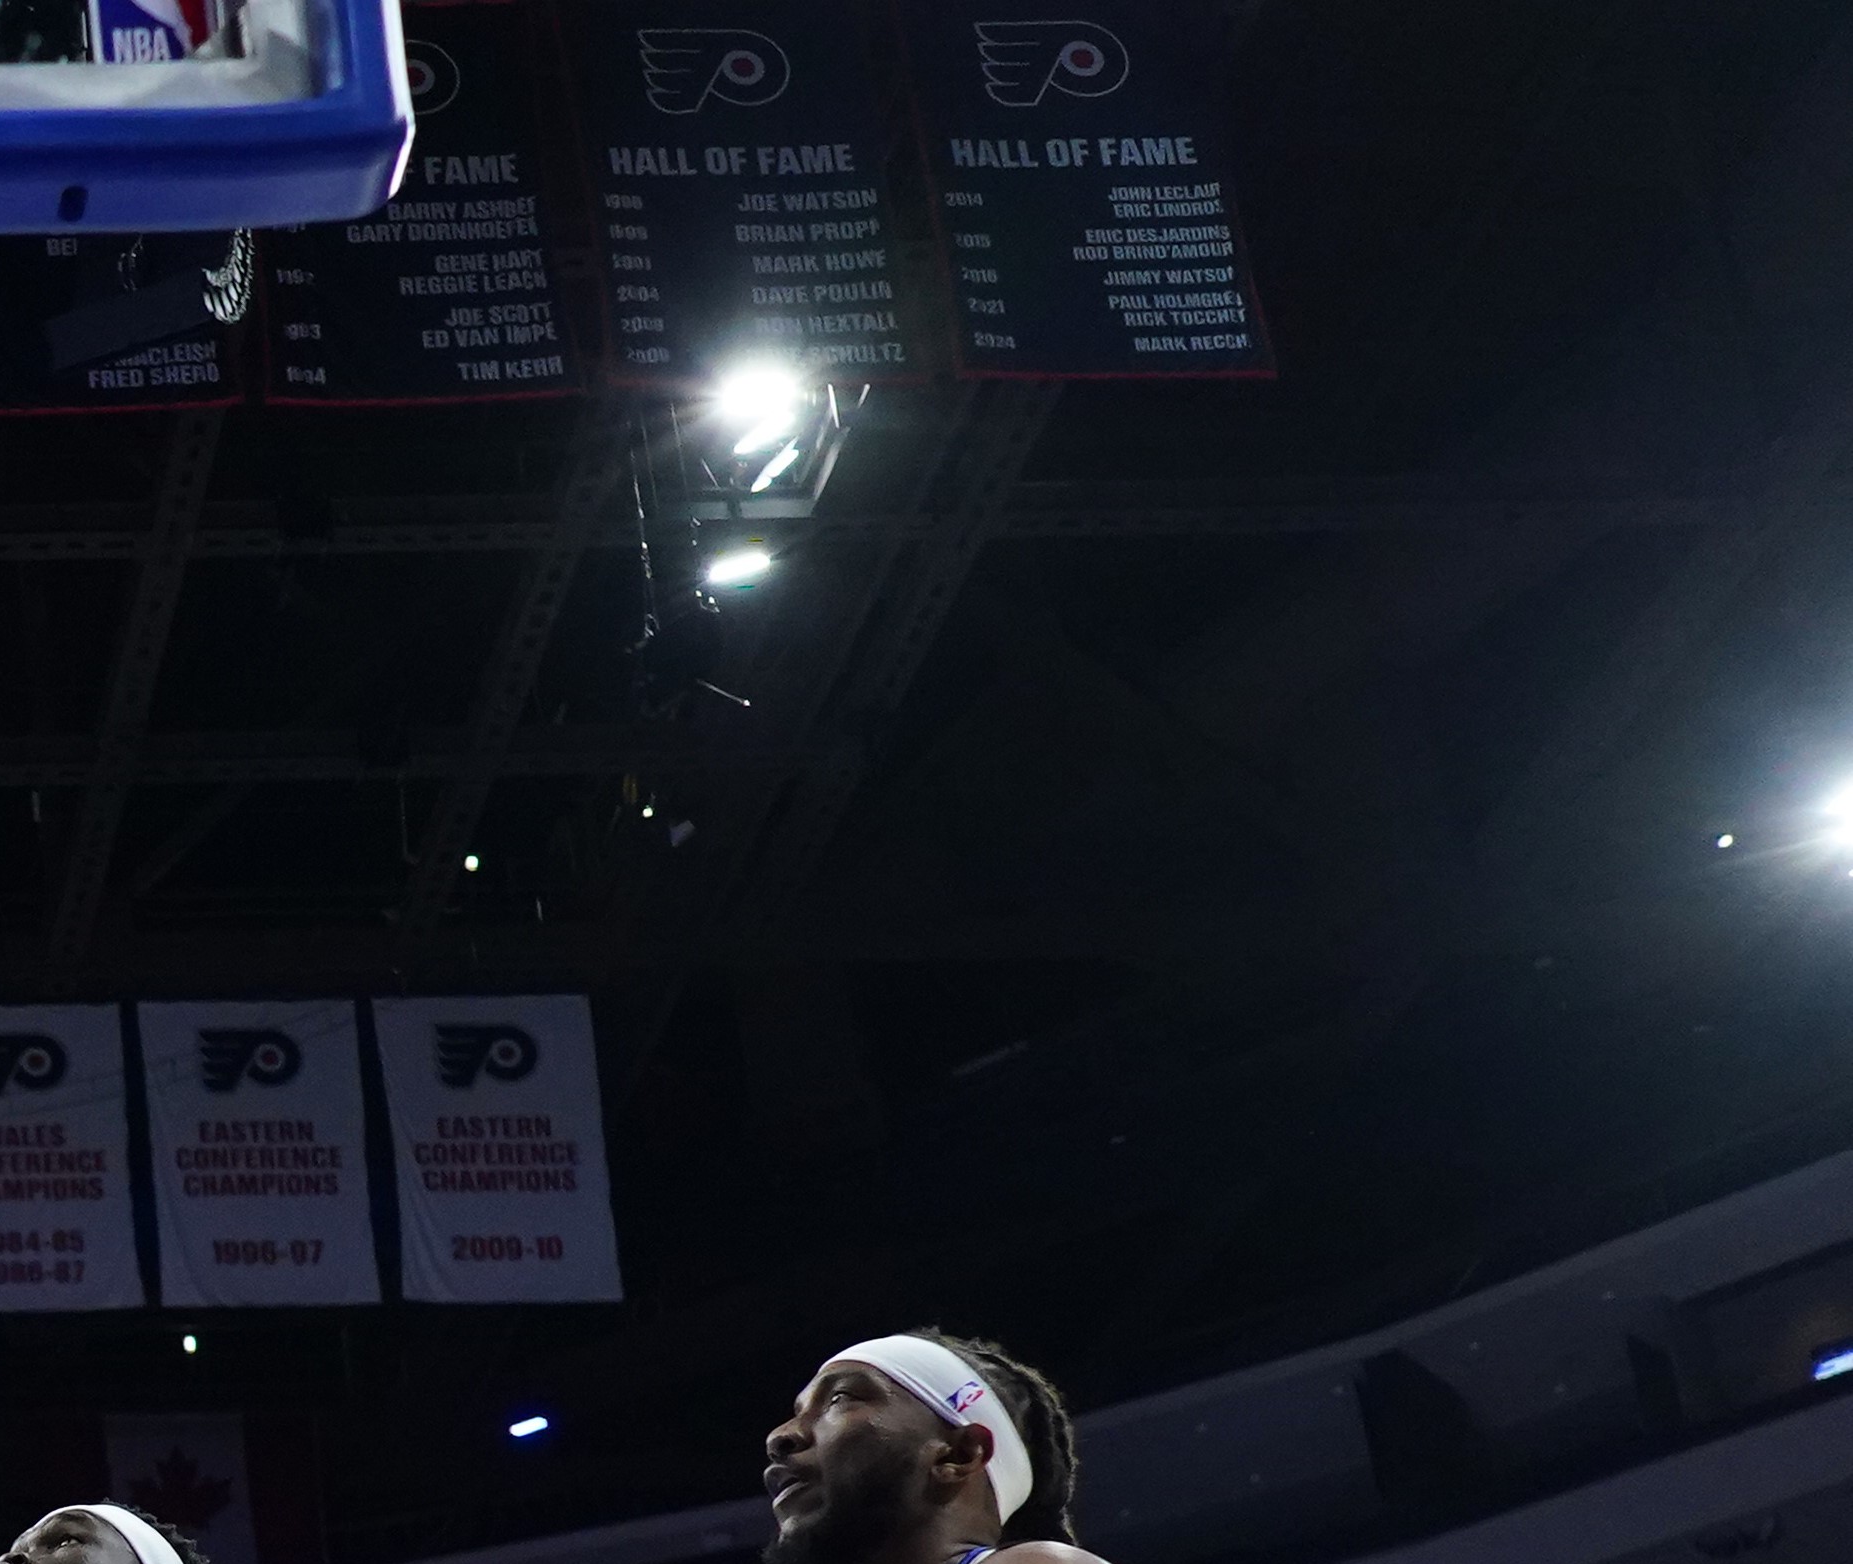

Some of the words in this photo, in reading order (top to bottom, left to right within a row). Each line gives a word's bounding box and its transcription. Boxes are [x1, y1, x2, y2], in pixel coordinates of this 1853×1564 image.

[111, 27, 171, 63] NBA
[608, 146, 698, 177] HALL
[704, 146, 747, 177] OF
[756, 143, 856, 176] FAME
[949, 137, 1039, 168] HALL
[1045, 137, 1091, 168] OF
[1097, 135, 1198, 167] FAME
[423, 154, 519, 185] FAME
[736, 192, 779, 213] JOE
[782, 187, 879, 212] WATSON
[1107, 186, 1152, 201] JOHN
[387, 202, 458, 222] BARRY
[1113, 203, 1151, 219] ERIC
[346, 221, 403, 244] GARY
[734, 222, 806, 243] BRIAN
[1084, 228, 1124, 244] ERIC
[434, 252, 489, 274] GENE
[751, 254, 820, 274] MARK
[398, 274, 480, 297] REGGIE
[483, 270, 548, 294] LEACH
[1102, 269, 1161, 286] JIMMY
[812, 279, 894, 303] POULIN
[1107, 293, 1152, 310] PAUL
[445, 305, 486, 328] JOE
[489, 301, 553, 326] SCOTT
[1123, 310, 1167, 328] RICK
[421, 329, 451, 350] ED
[454, 325, 501, 348] VAN
[505, 321, 559, 346] IMPE
[1133, 336, 1188, 353] MARK
[89, 368, 143, 389] FRED
[457, 360, 501, 382] TIM
[505, 355, 564, 380] KERR
[198, 1119, 315, 1145] EASTERN
[435, 1115, 552, 1140] EASTERN
[175, 1144, 343, 1171] CONFERENCE
[413, 1139, 581, 1167] CONFERENCE
[182, 1171, 340, 1198] CHAMPIONS
[421, 1168, 579, 1194] CHAMPIONS
[450, 1234, 564, 1261] 2009-10
